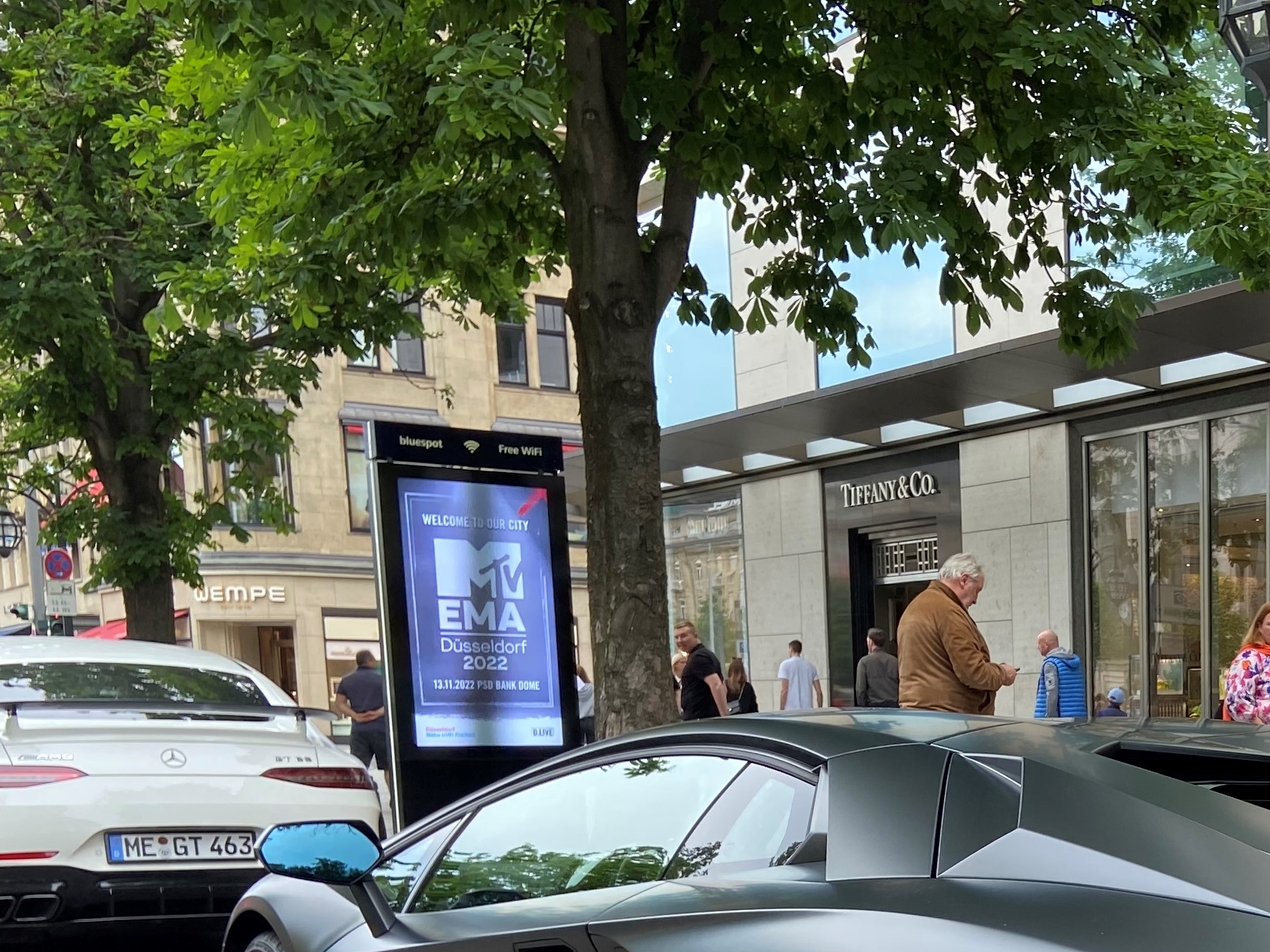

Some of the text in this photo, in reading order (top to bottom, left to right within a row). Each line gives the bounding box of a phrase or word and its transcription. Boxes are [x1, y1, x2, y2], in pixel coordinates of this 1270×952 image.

[399, 436, 443, 450] bluespot
[498, 444, 543, 457] Free WiFi
[422, 513, 529, 531] WELCOME TO OUR CITY
[433, 538, 524, 600] MTV
[194, 585, 286, 602] WEMPE
[438, 599, 526, 632] EMA
[440, 637, 527, 655] Düsseldorf
[463, 656, 508, 671] 2022
[433, 679, 540, 691] 13.11.2022 PSD BANK DOME
[124, 837, 157, 858] ME
[173, 836, 202, 856] GT
[210, 836, 251, 856] 463
